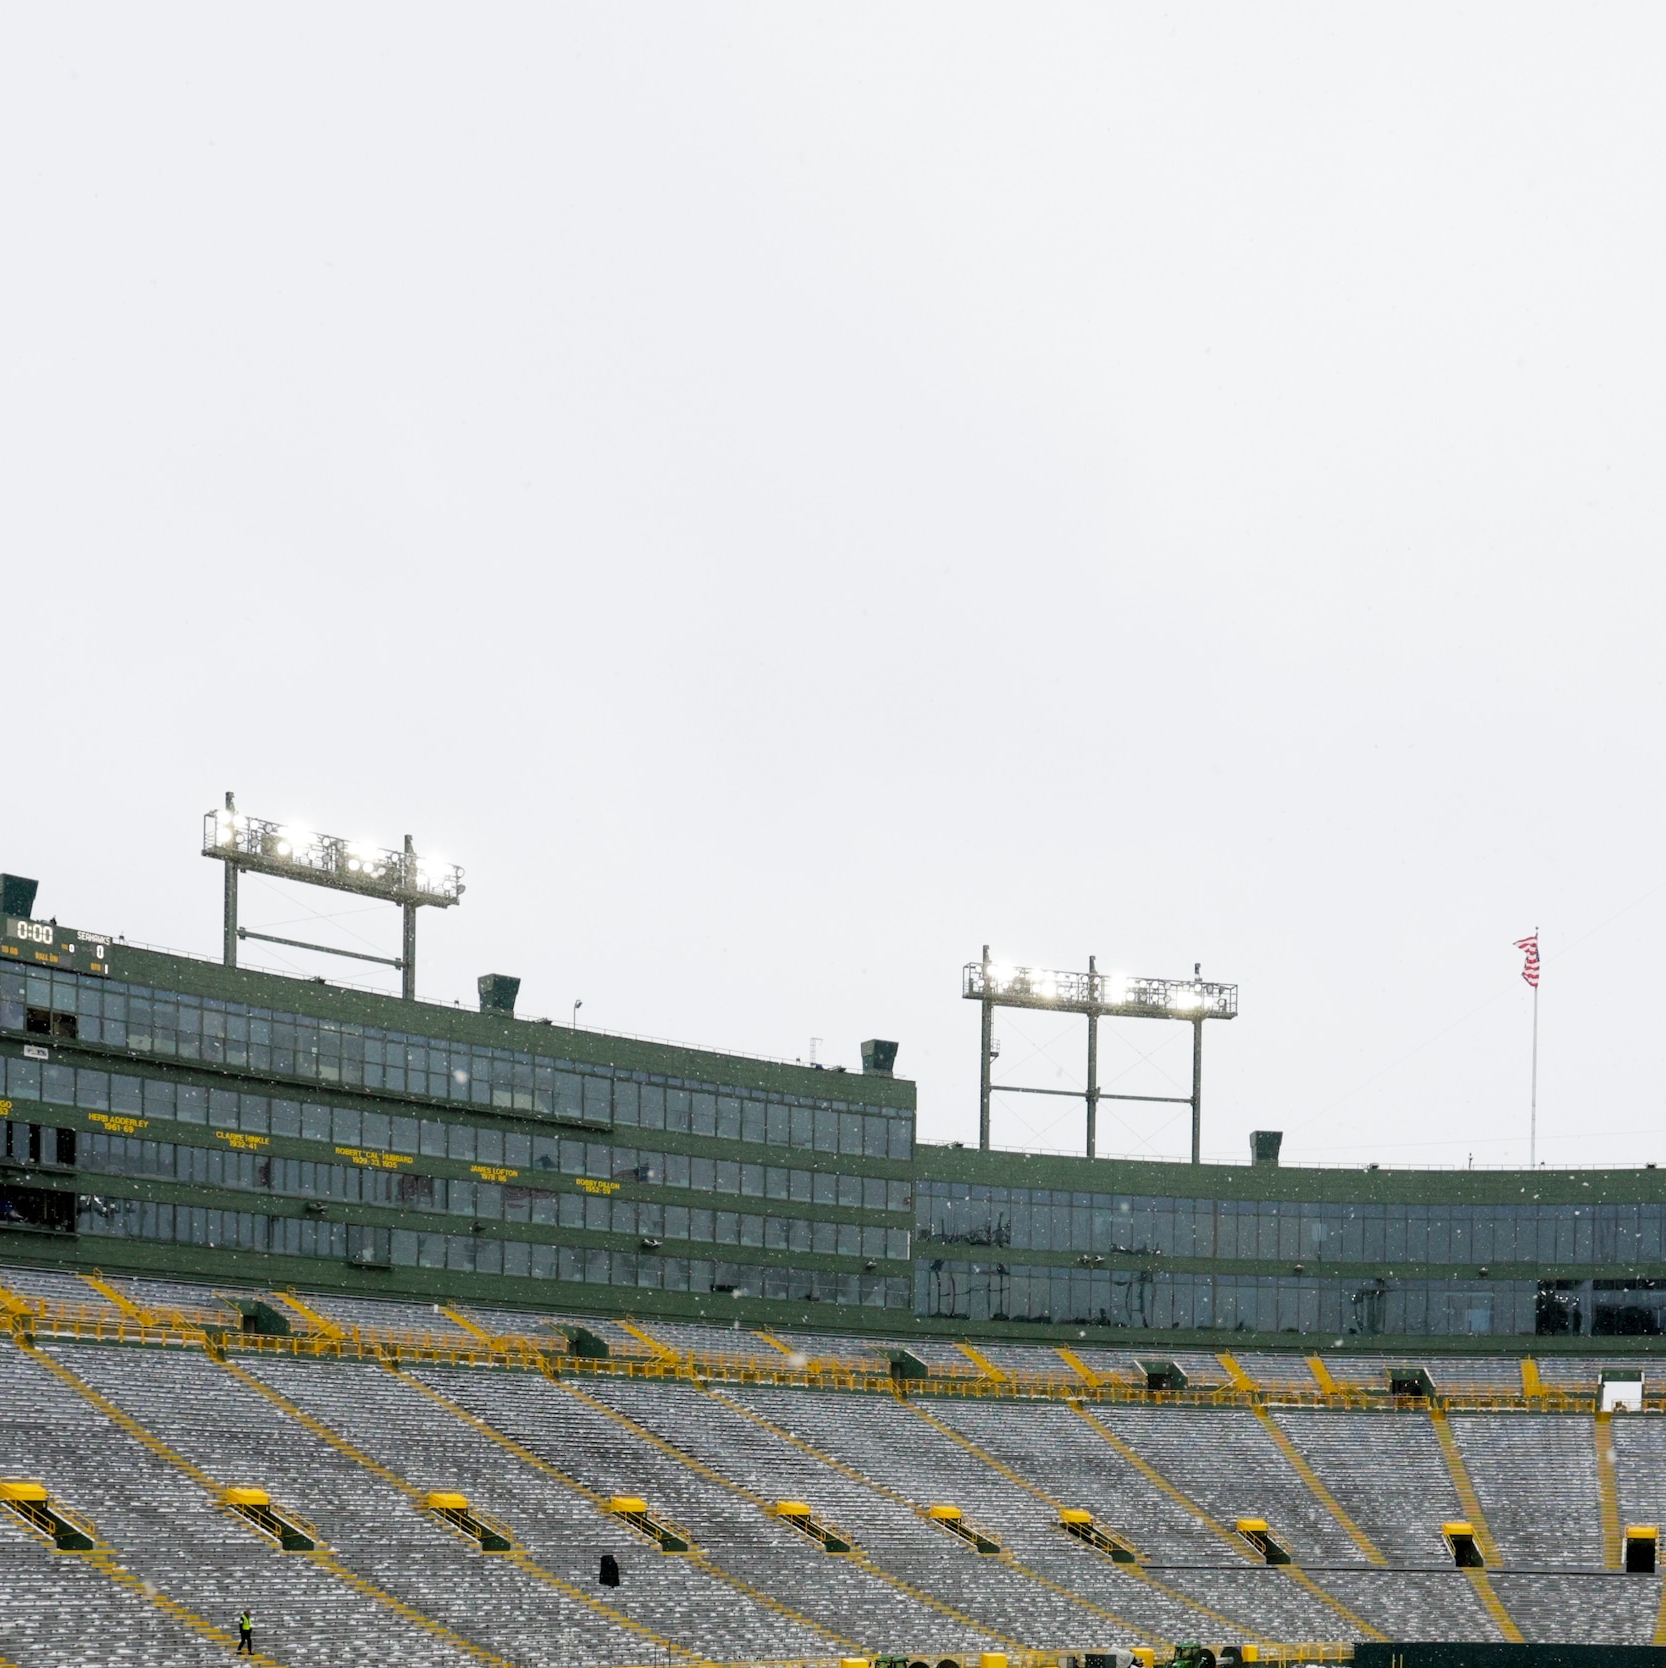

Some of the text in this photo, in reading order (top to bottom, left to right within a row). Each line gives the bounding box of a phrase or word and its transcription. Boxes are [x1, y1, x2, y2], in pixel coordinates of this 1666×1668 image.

[17, 921, 53, 944] 0:00
[77, 931, 111, 946] SEAHAWKS
[96, 945, 104, 959] 0
[88, 1113, 149, 1129] HERB ADDERLEY
